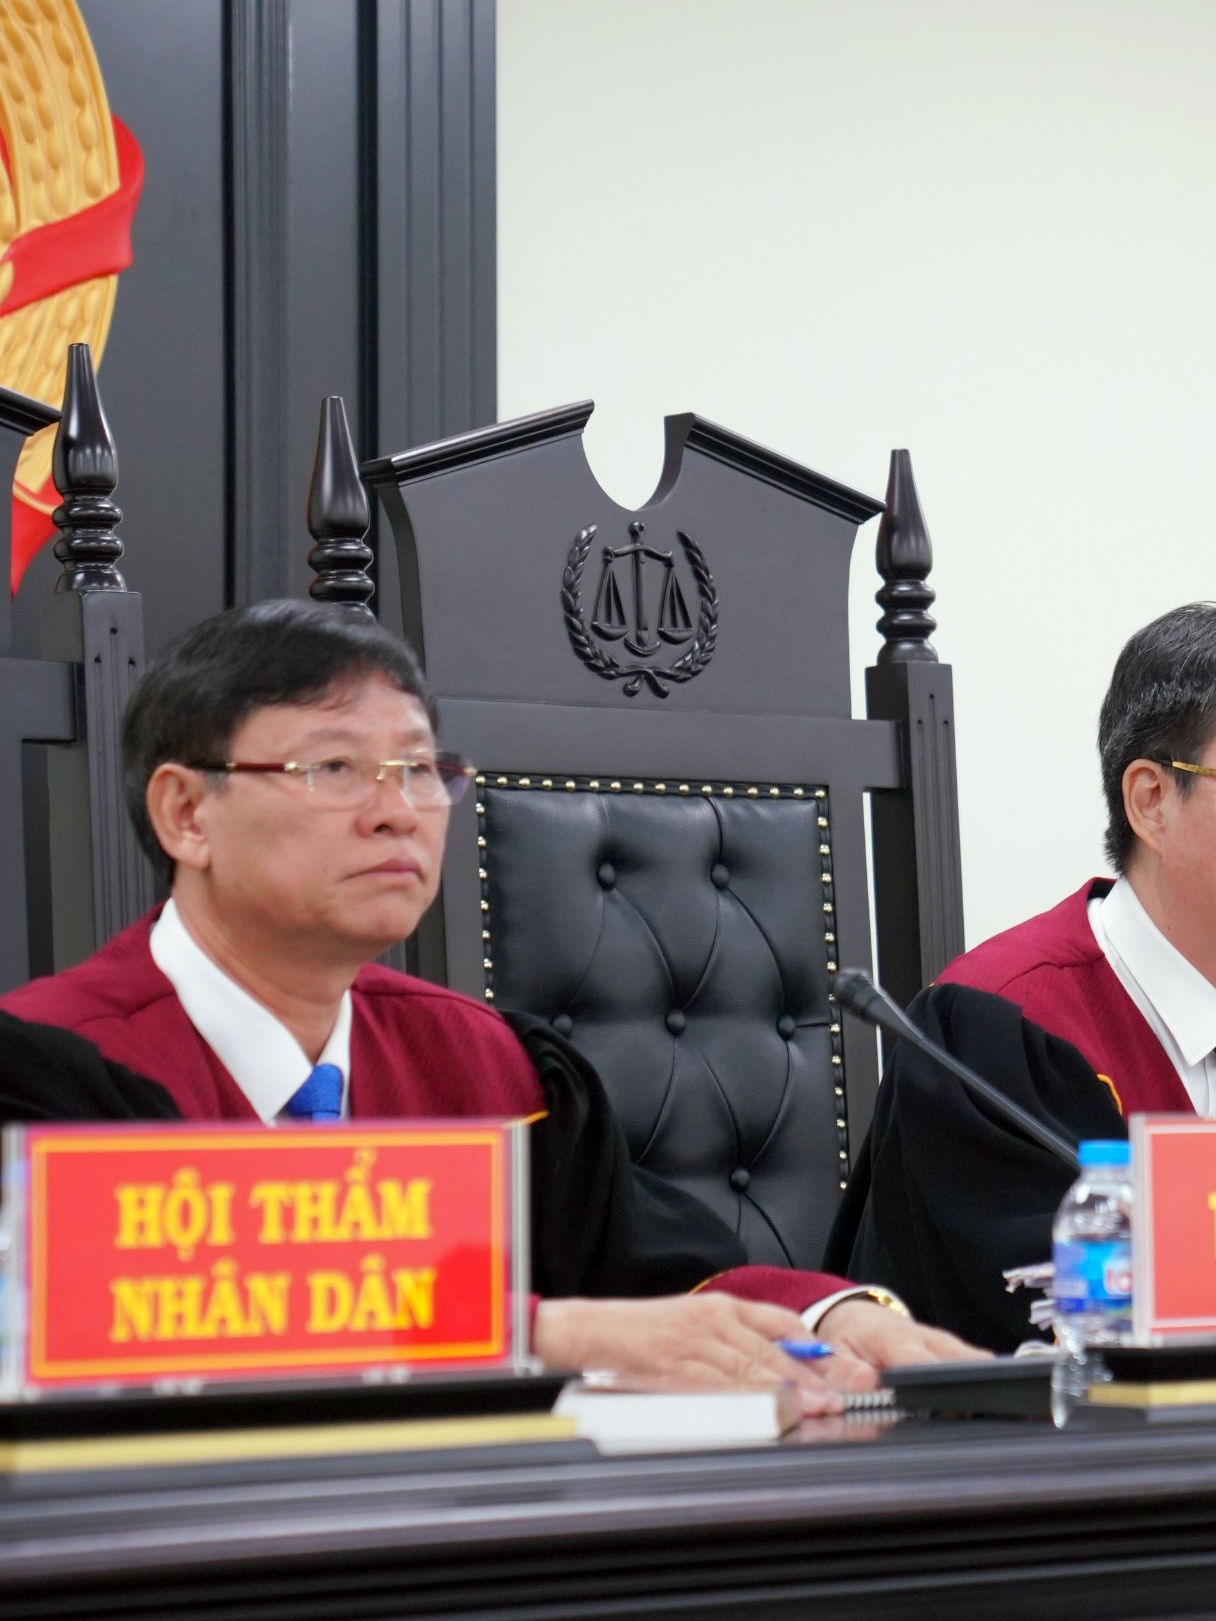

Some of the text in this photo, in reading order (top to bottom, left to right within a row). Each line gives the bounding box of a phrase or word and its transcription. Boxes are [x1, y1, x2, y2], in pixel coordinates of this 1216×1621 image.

[114, 1147, 433, 1262] HỘI THẨM
[109, 1252, 436, 1343] NHÂN DÂN
